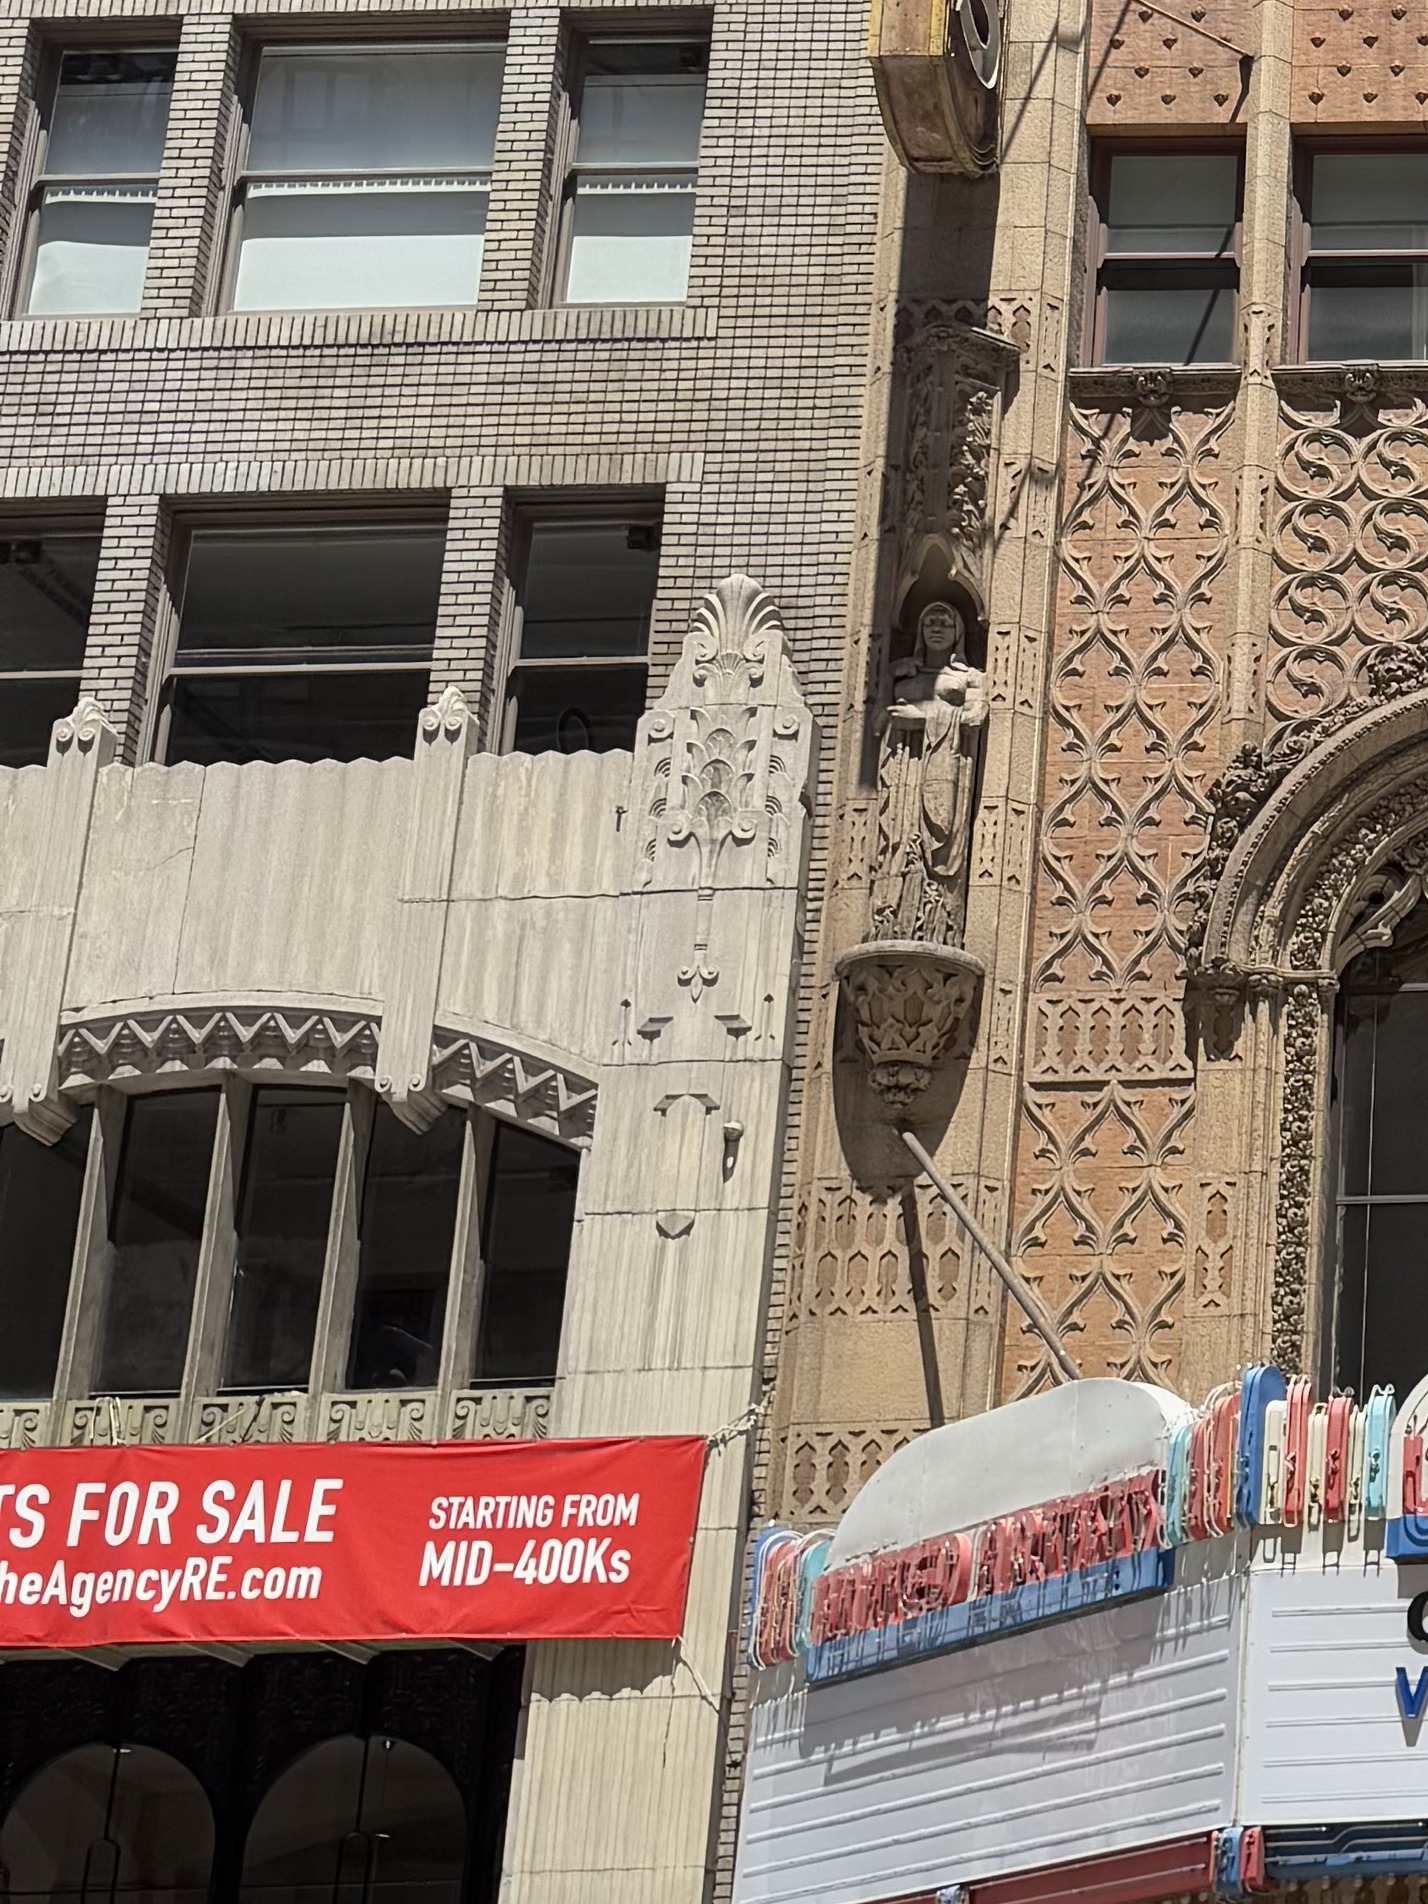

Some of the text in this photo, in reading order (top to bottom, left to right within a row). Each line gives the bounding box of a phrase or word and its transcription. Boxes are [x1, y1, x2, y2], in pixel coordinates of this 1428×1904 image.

[66, 1481, 179, 1547] FOR
[196, 1478, 344, 1544] SALE
[429, 1492, 640, 1530] STARTING FROM
[418, 1537, 632, 1587] MID-400Ks
